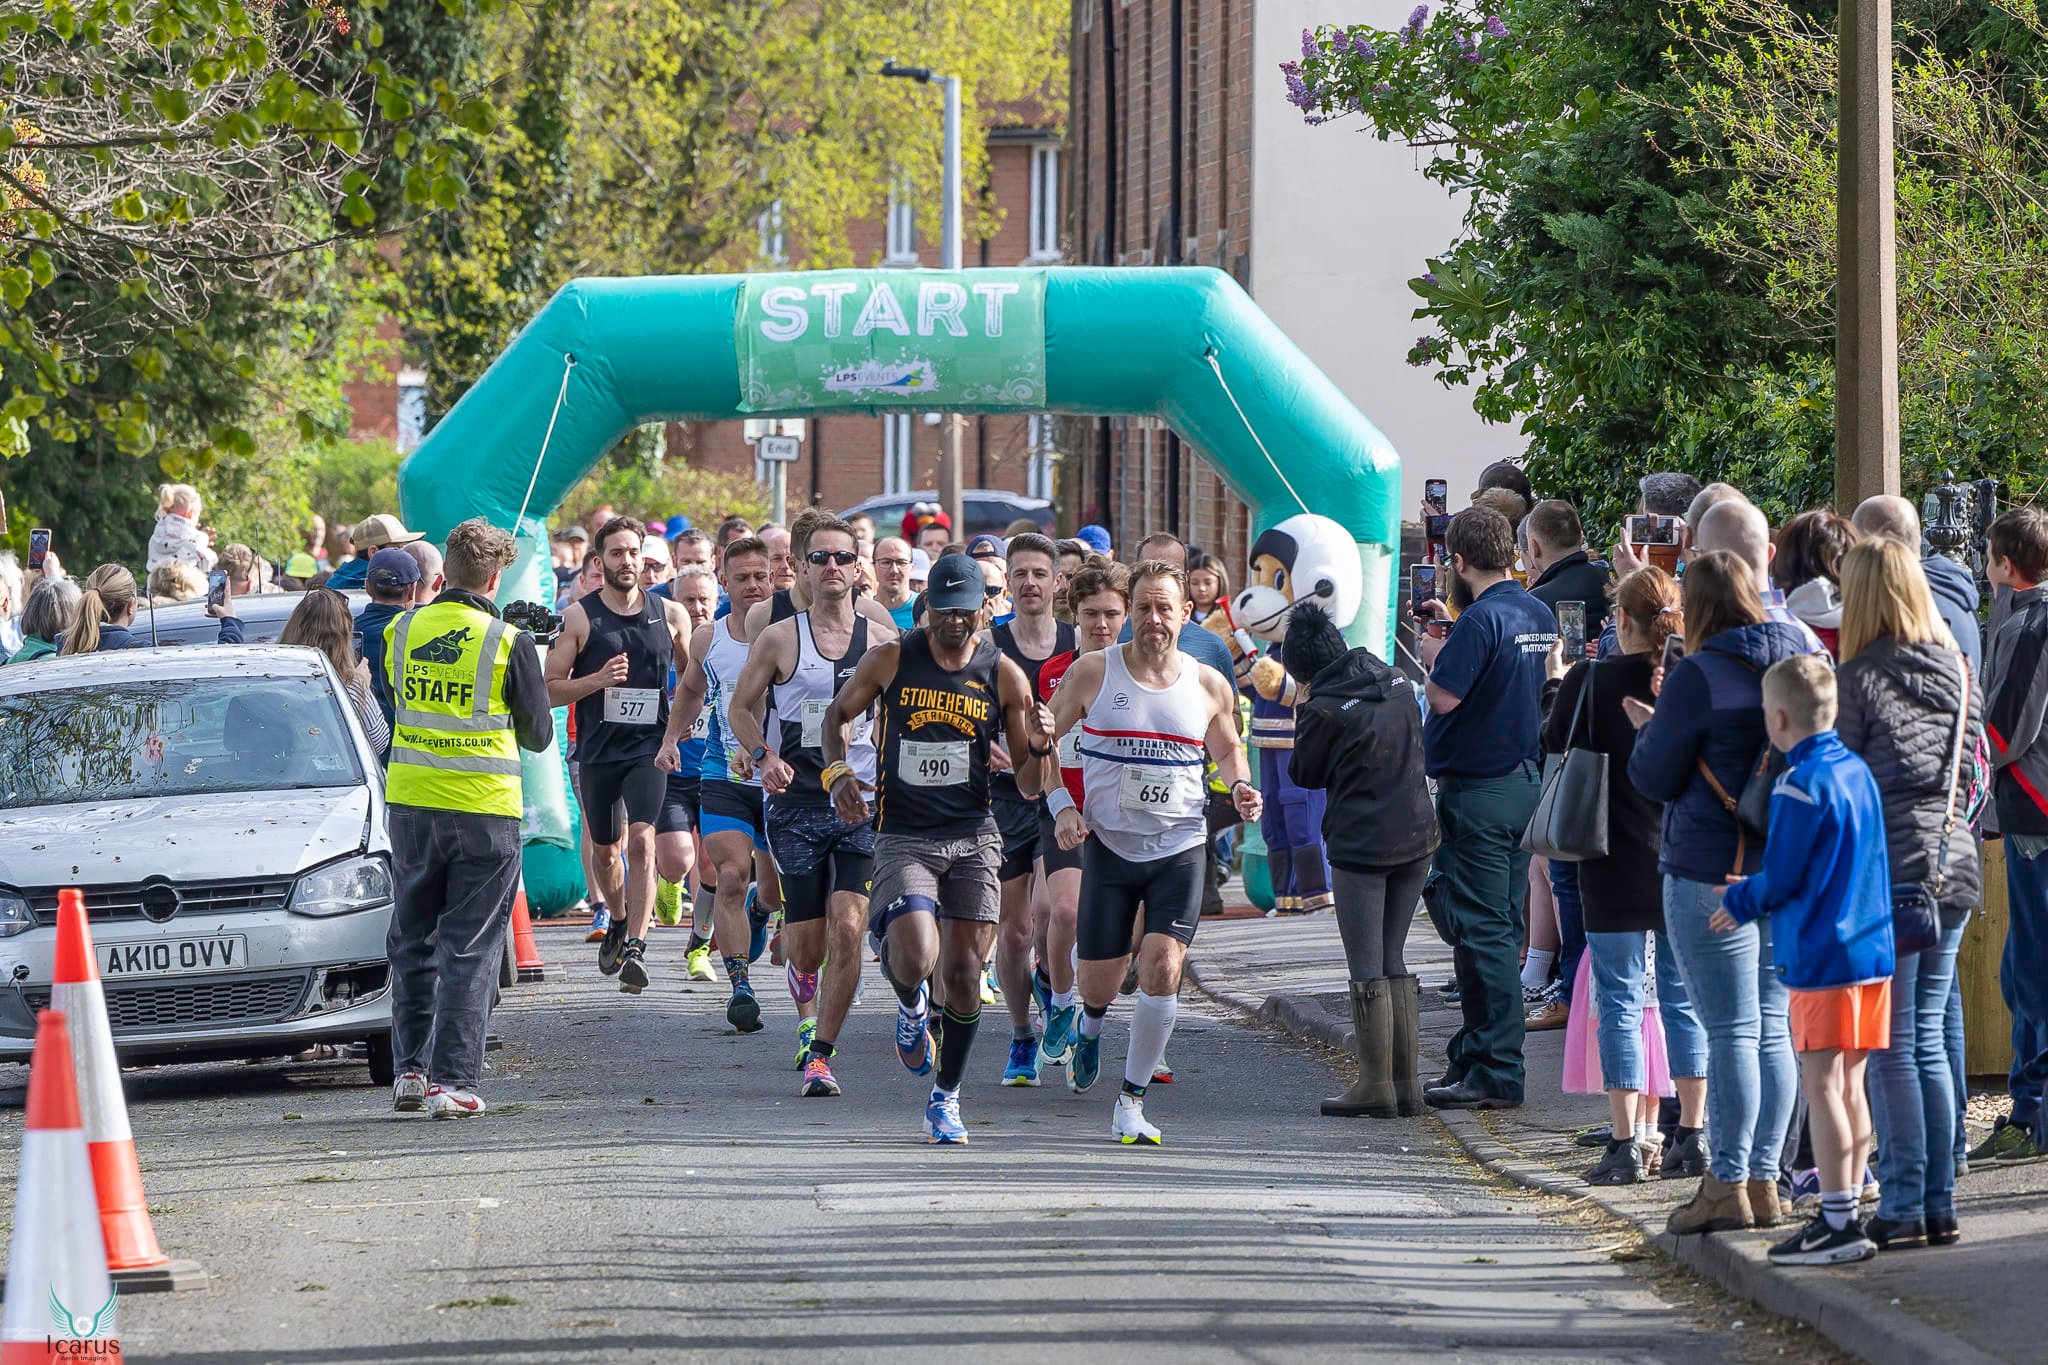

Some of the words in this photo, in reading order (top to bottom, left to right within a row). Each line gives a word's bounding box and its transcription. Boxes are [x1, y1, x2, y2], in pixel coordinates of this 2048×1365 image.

[760, 281, 1019, 342] START
[767, 442, 792, 454] End
[1540, 633, 1559, 642] NURSE
[405, 676, 473, 706] STAFF
[619, 701, 645, 717] 577
[899, 687, 990, 721] STONEHENGE
[913, 711, 972, 731] STRIDERS
[1117, 739, 1134, 747] SAN
[1132, 748, 1169, 758] CARDIFF
[919, 759, 950, 777] 490
[1140, 785, 1170, 804] 656
[108, 945, 171, 973] AK10
[179, 940, 235, 968] OVV
